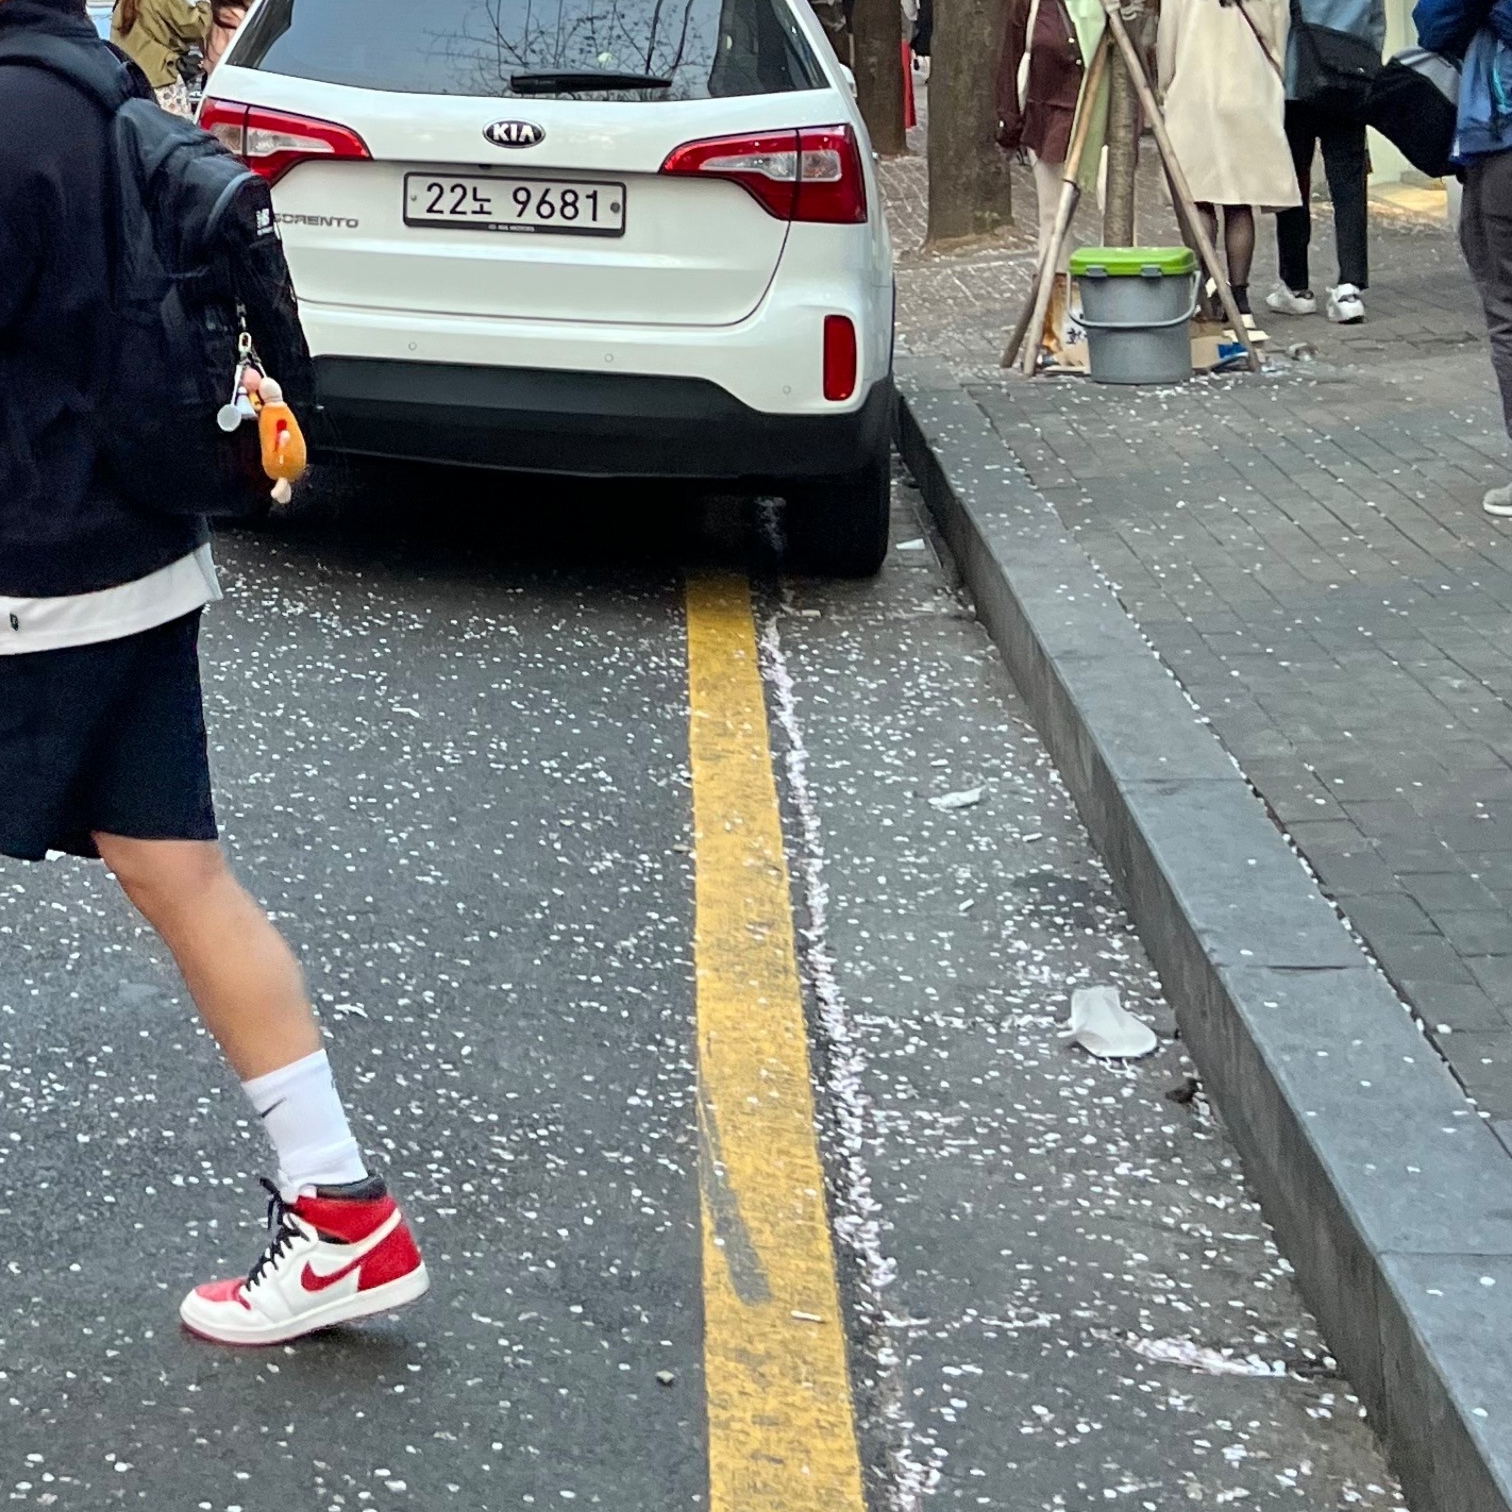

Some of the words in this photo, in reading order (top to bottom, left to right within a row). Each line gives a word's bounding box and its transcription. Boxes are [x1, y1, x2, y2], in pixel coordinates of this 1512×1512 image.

[492, 123, 536, 143] KIA
[426, 182, 492, 216] 22노
[512, 186, 599, 222] 9681
